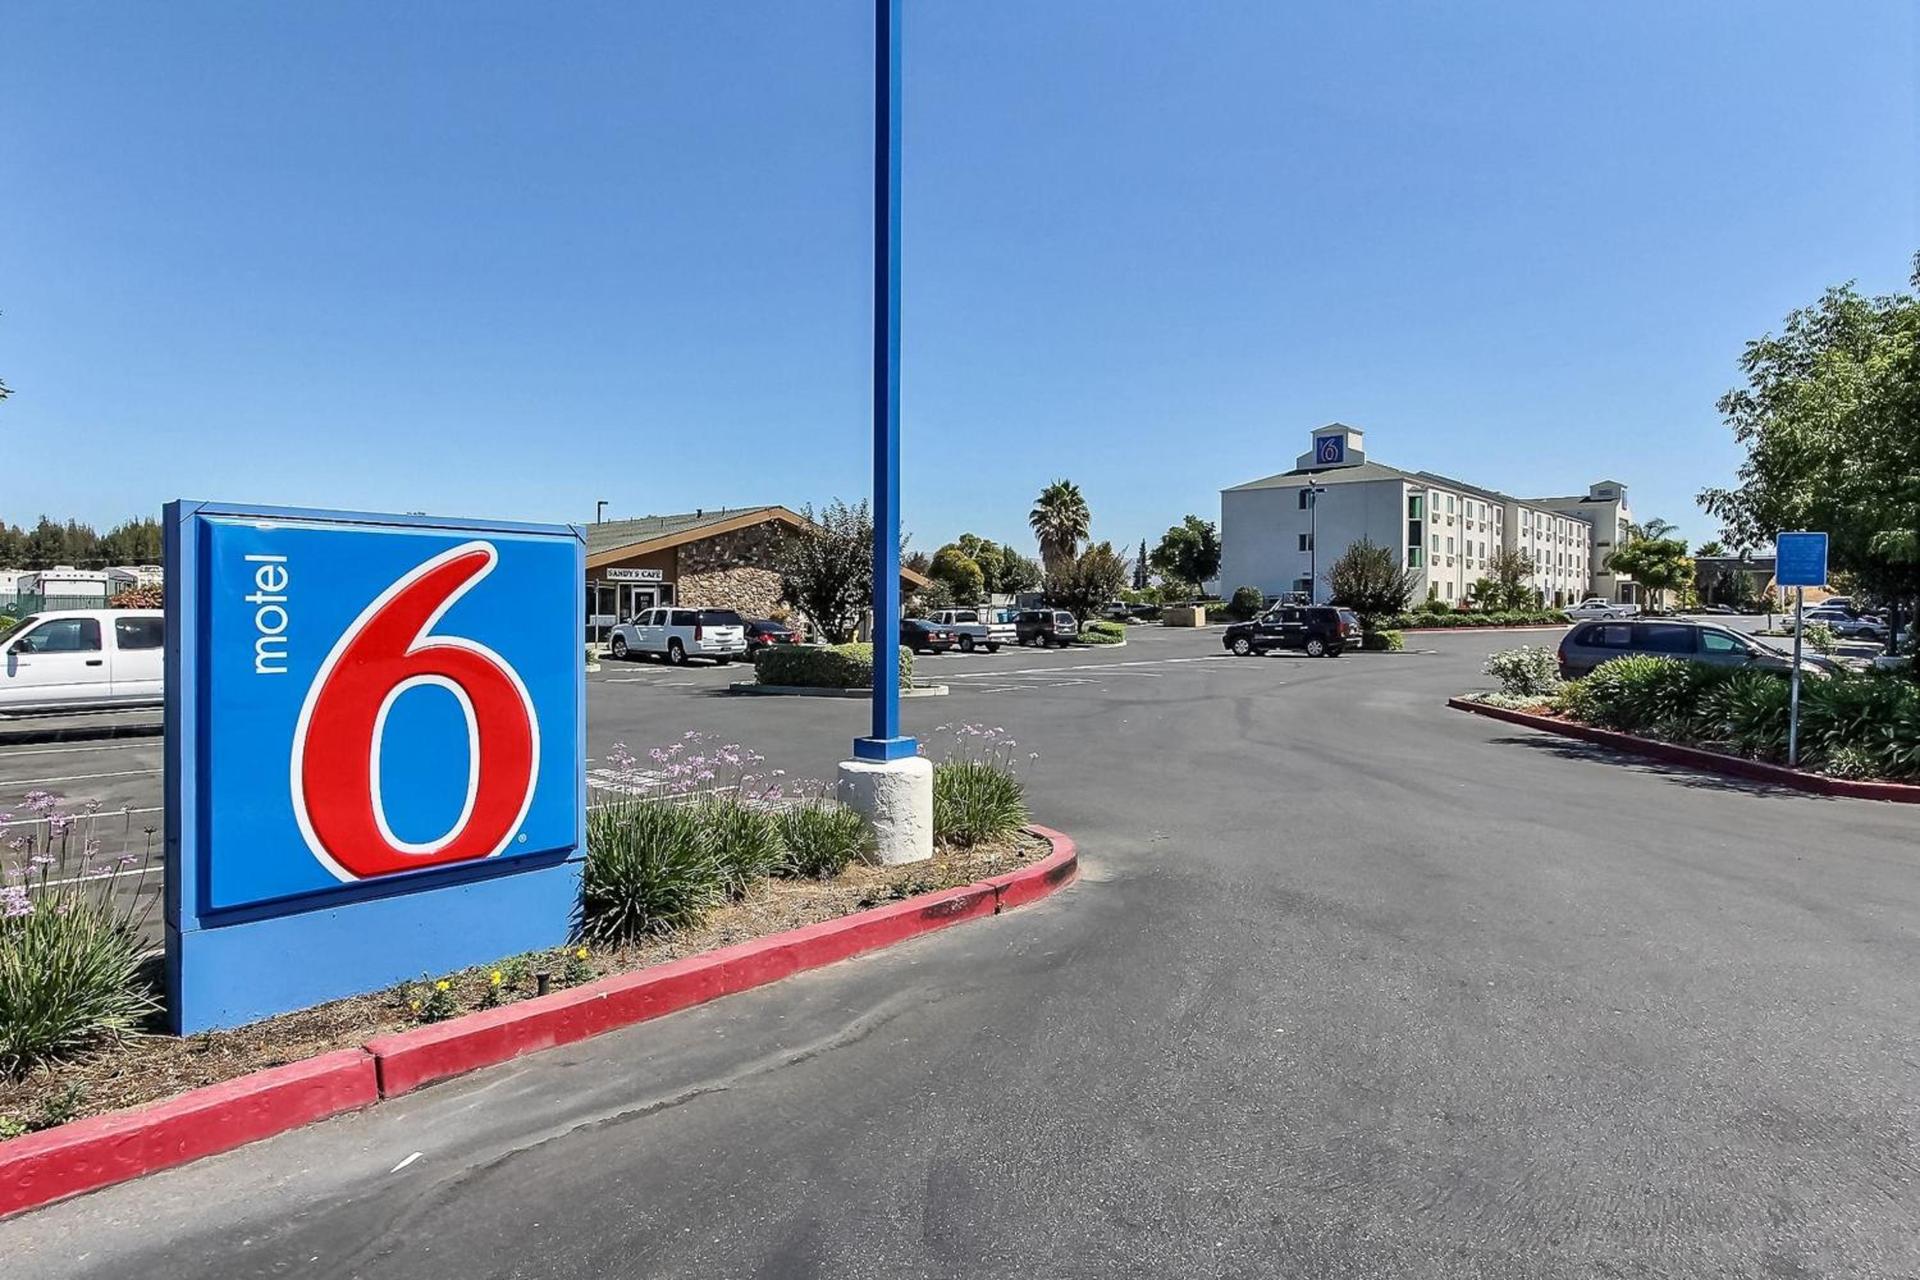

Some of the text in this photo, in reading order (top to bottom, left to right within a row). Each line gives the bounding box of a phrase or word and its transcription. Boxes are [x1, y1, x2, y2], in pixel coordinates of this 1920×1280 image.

[1321, 438, 1339, 462] 6
[641, 569, 661, 579] CAFE
[244, 540, 541, 883] motel 6
